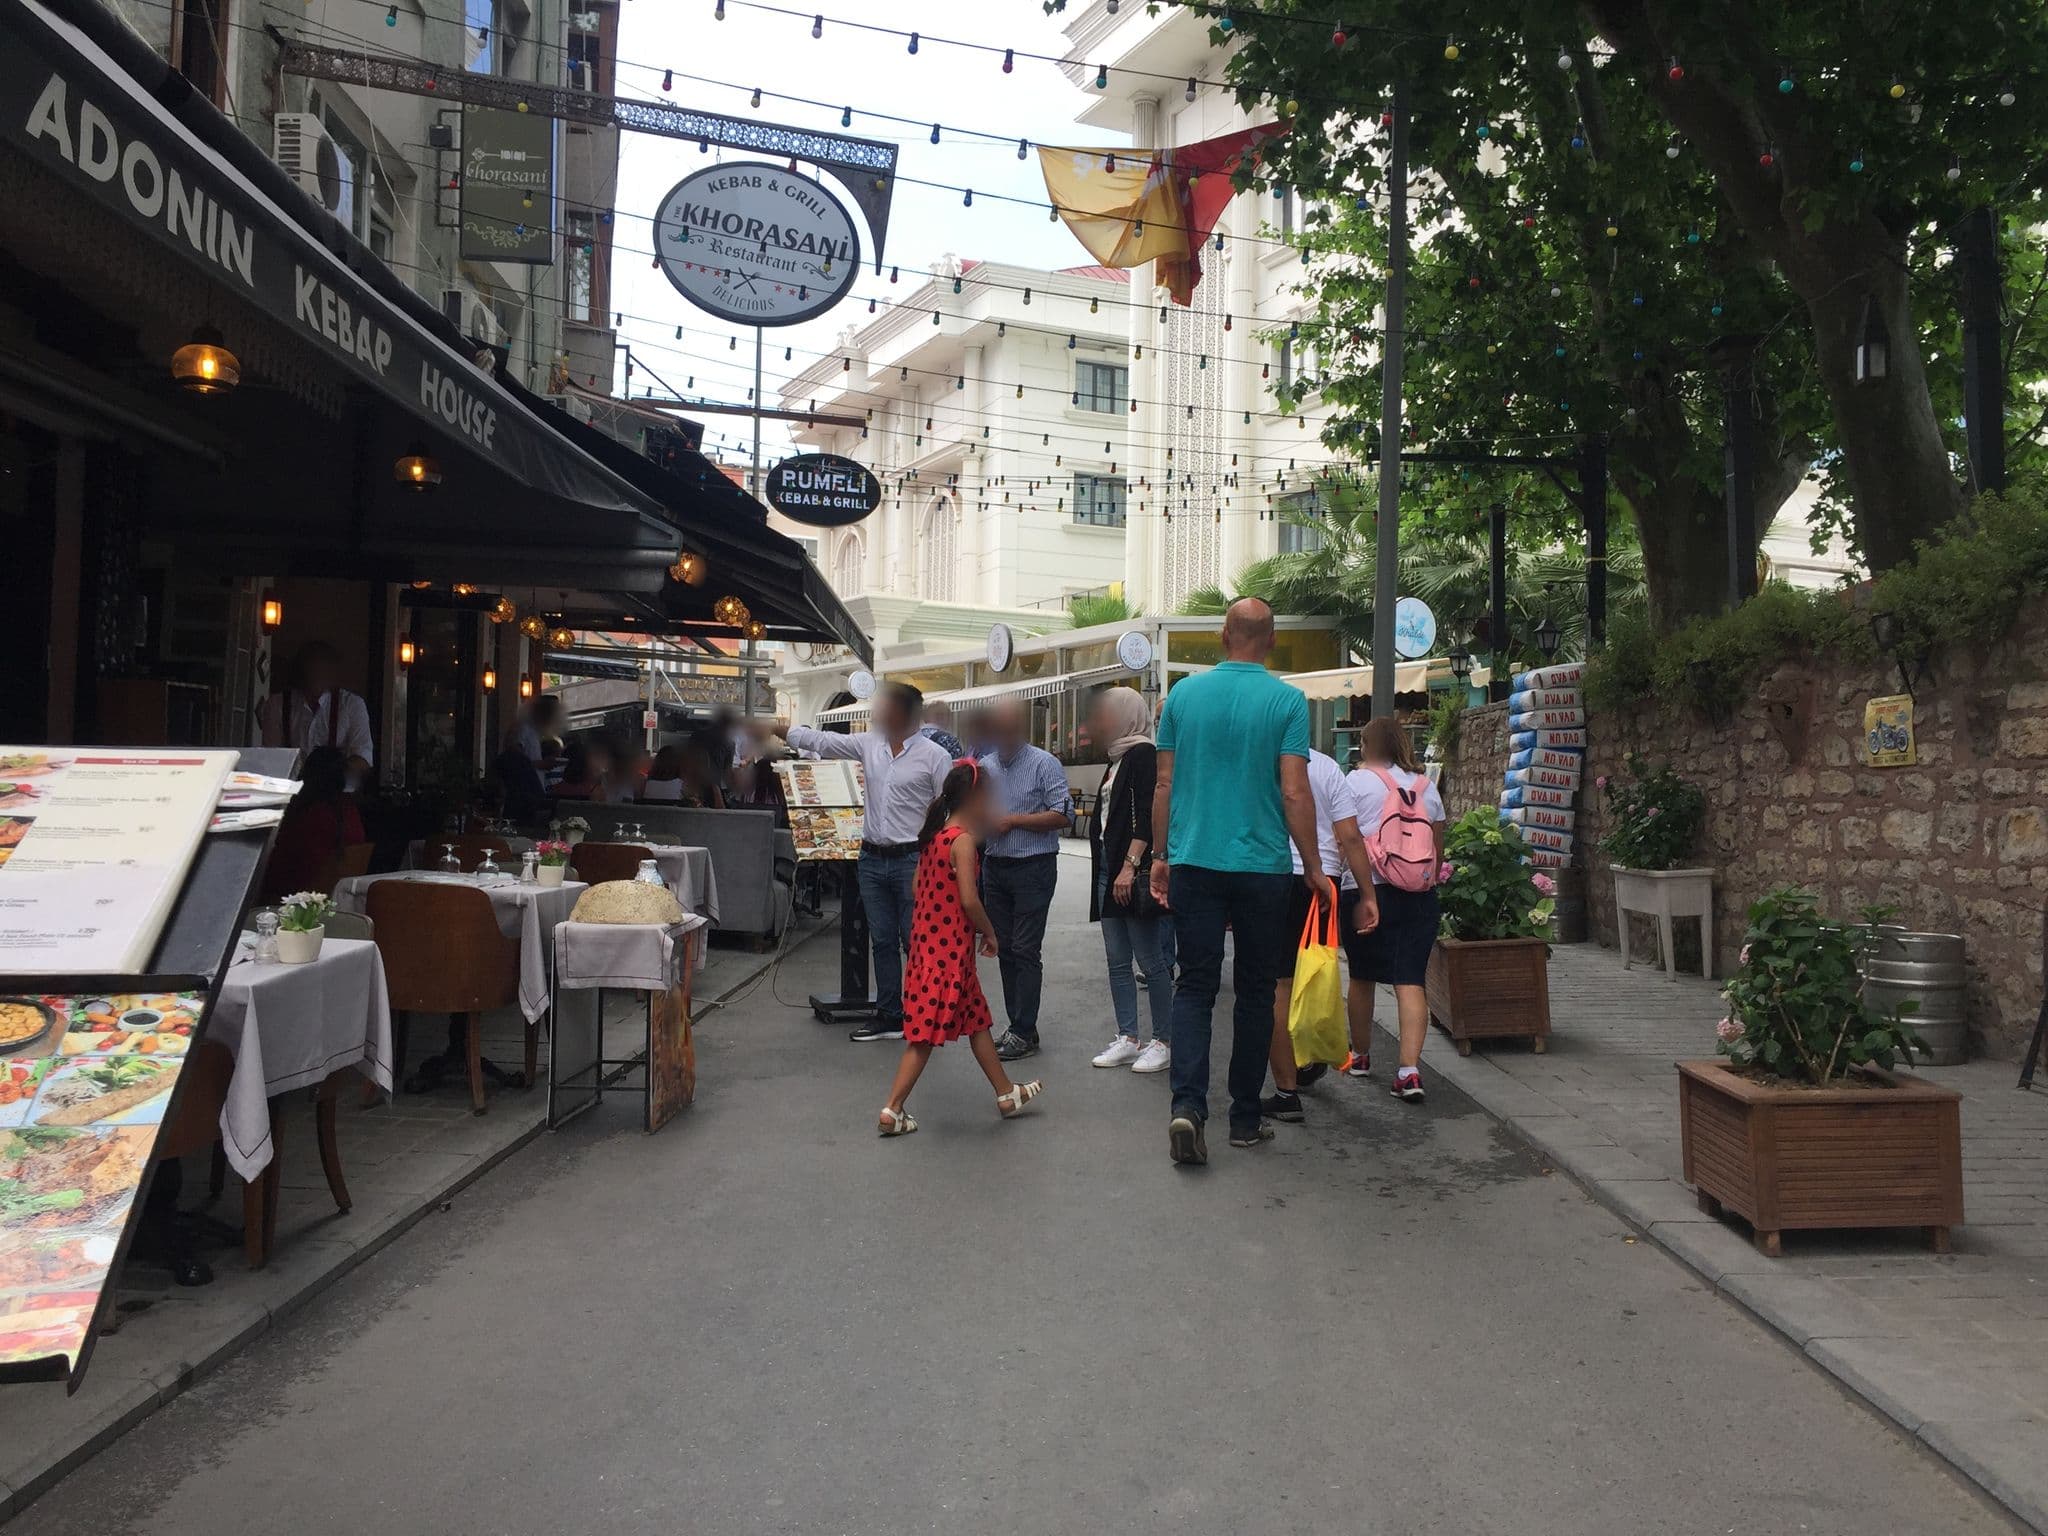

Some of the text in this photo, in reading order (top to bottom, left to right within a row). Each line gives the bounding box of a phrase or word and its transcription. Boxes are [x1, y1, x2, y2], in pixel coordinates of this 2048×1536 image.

[707, 176, 829, 220] KEBAB & GRILL
[25, 72, 496, 450] ADONIN KEBAP HOUSE
[709, 237, 799, 273] Restaurant
[712, 284, 776, 312] DELICIOUS
[823, 497, 831, 507] &
[834, 497, 870, 510] GRILL
